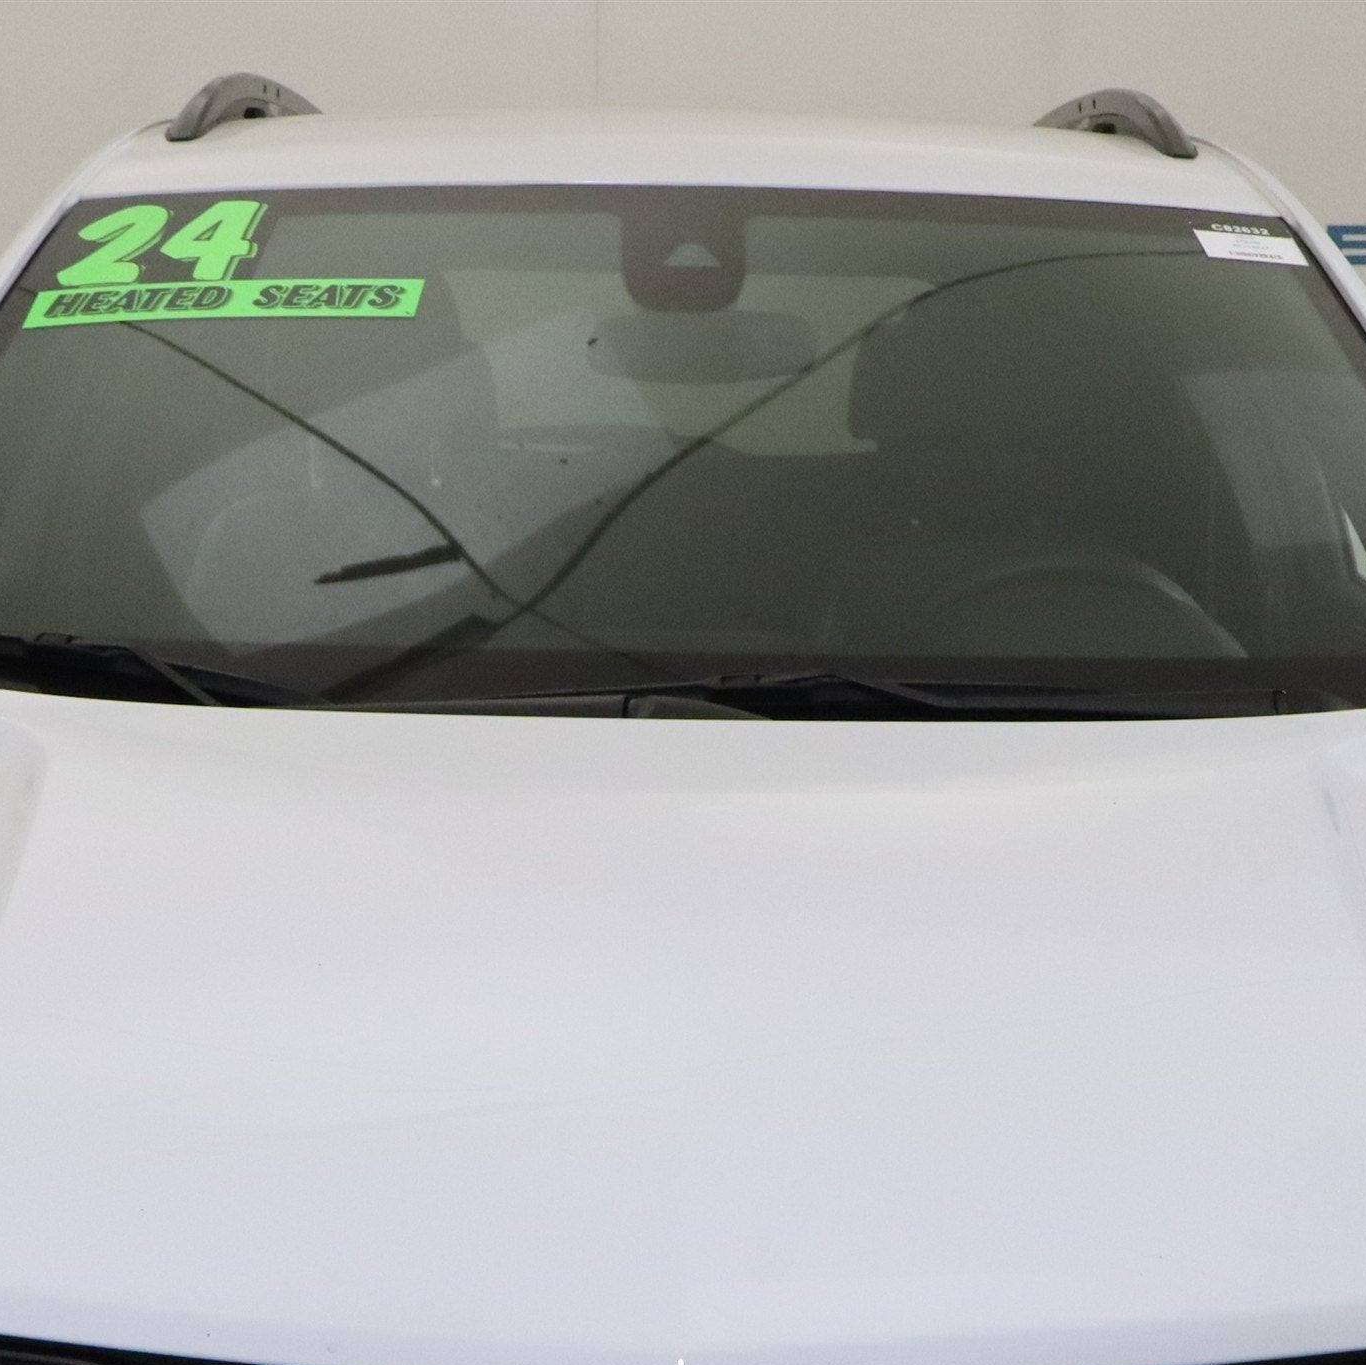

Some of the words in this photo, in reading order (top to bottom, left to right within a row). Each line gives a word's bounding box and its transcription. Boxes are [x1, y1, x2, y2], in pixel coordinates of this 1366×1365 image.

[56, 200, 267, 286] 24
[44, 285, 233, 318] HEATED
[252, 284, 407, 310] SEATS
